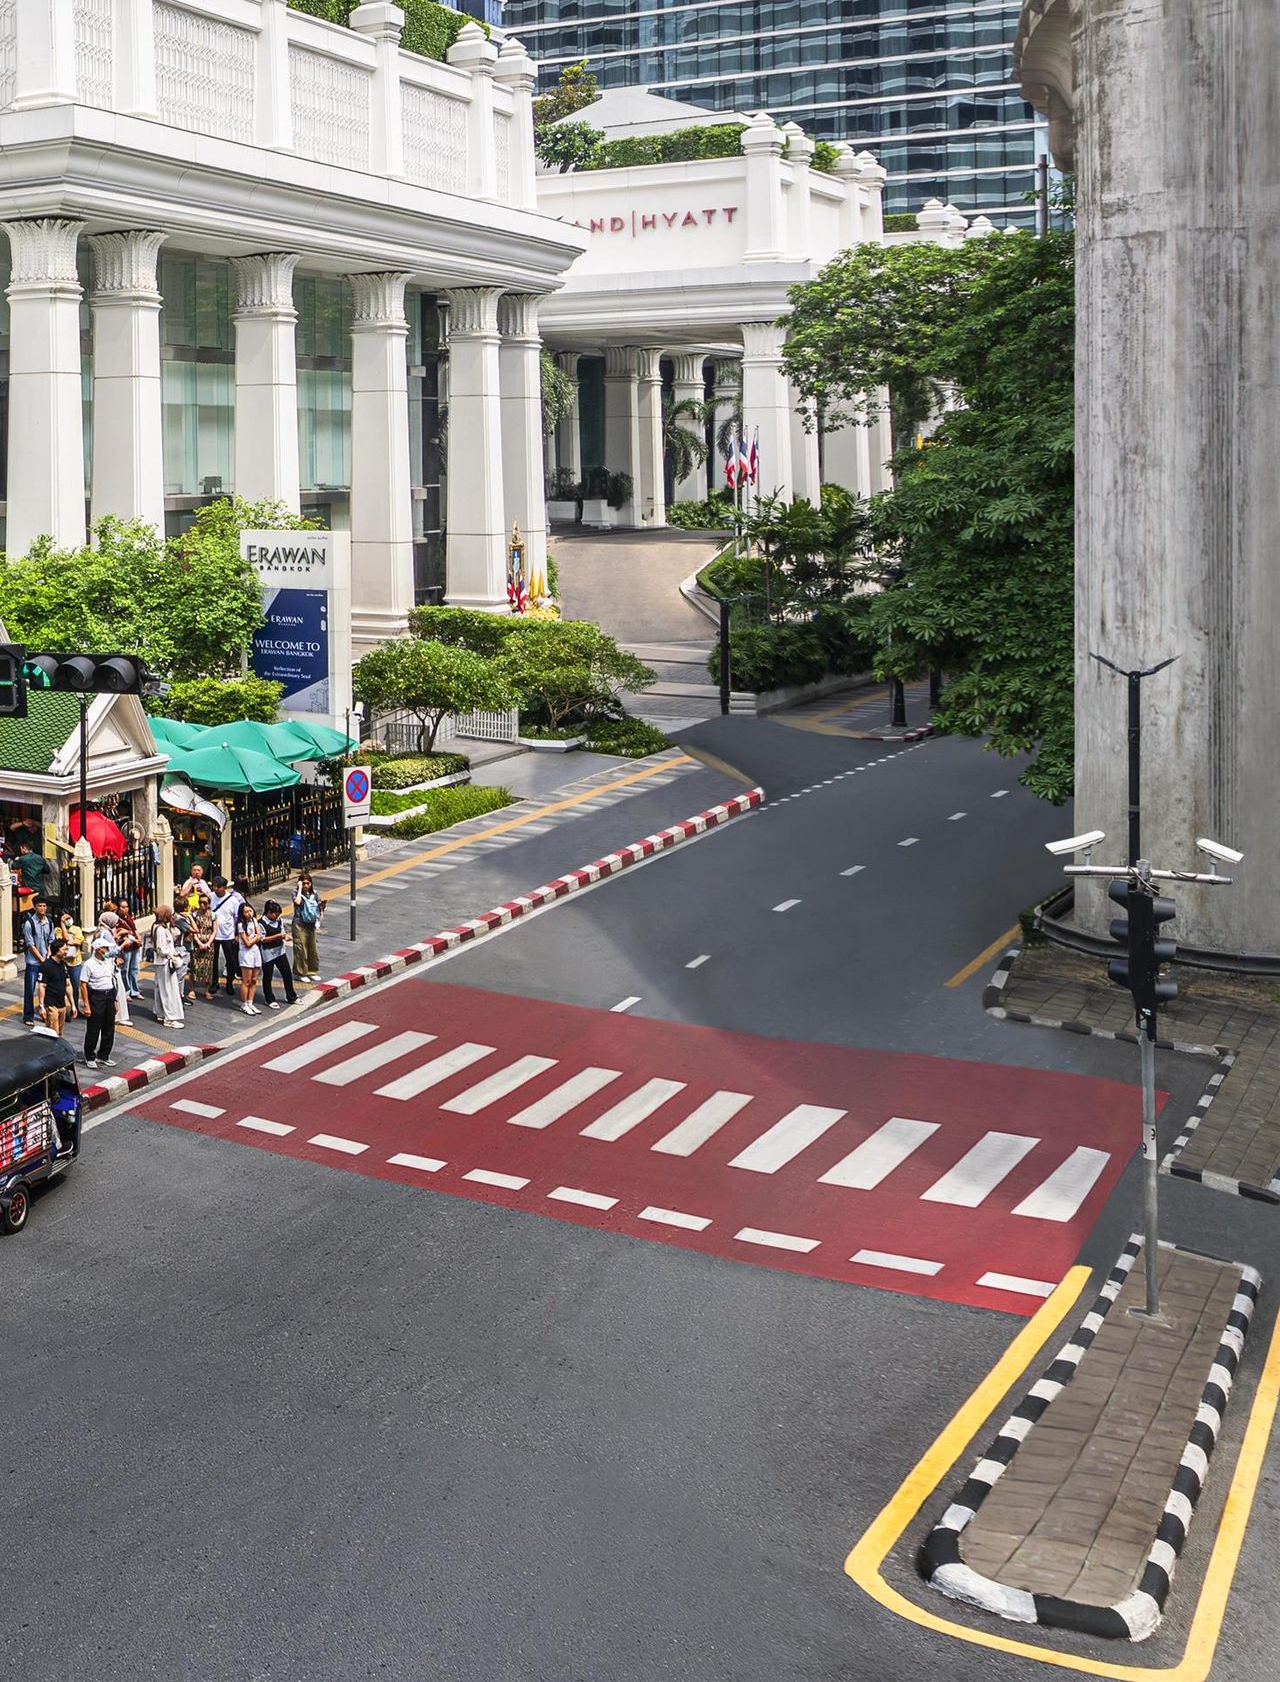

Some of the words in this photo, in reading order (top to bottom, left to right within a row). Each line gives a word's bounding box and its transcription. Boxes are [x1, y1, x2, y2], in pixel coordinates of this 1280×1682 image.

[642, 207, 738, 229] HYATT
[247, 545, 326, 566] ERAWAN
[271, 615, 303, 624] ERAWAN
[254, 639, 304, 651] WELCOME
[305, 641, 321, 652] TO
[261, 648, 285, 656] ERAWAN
[37, 972, 43, 981] 3
